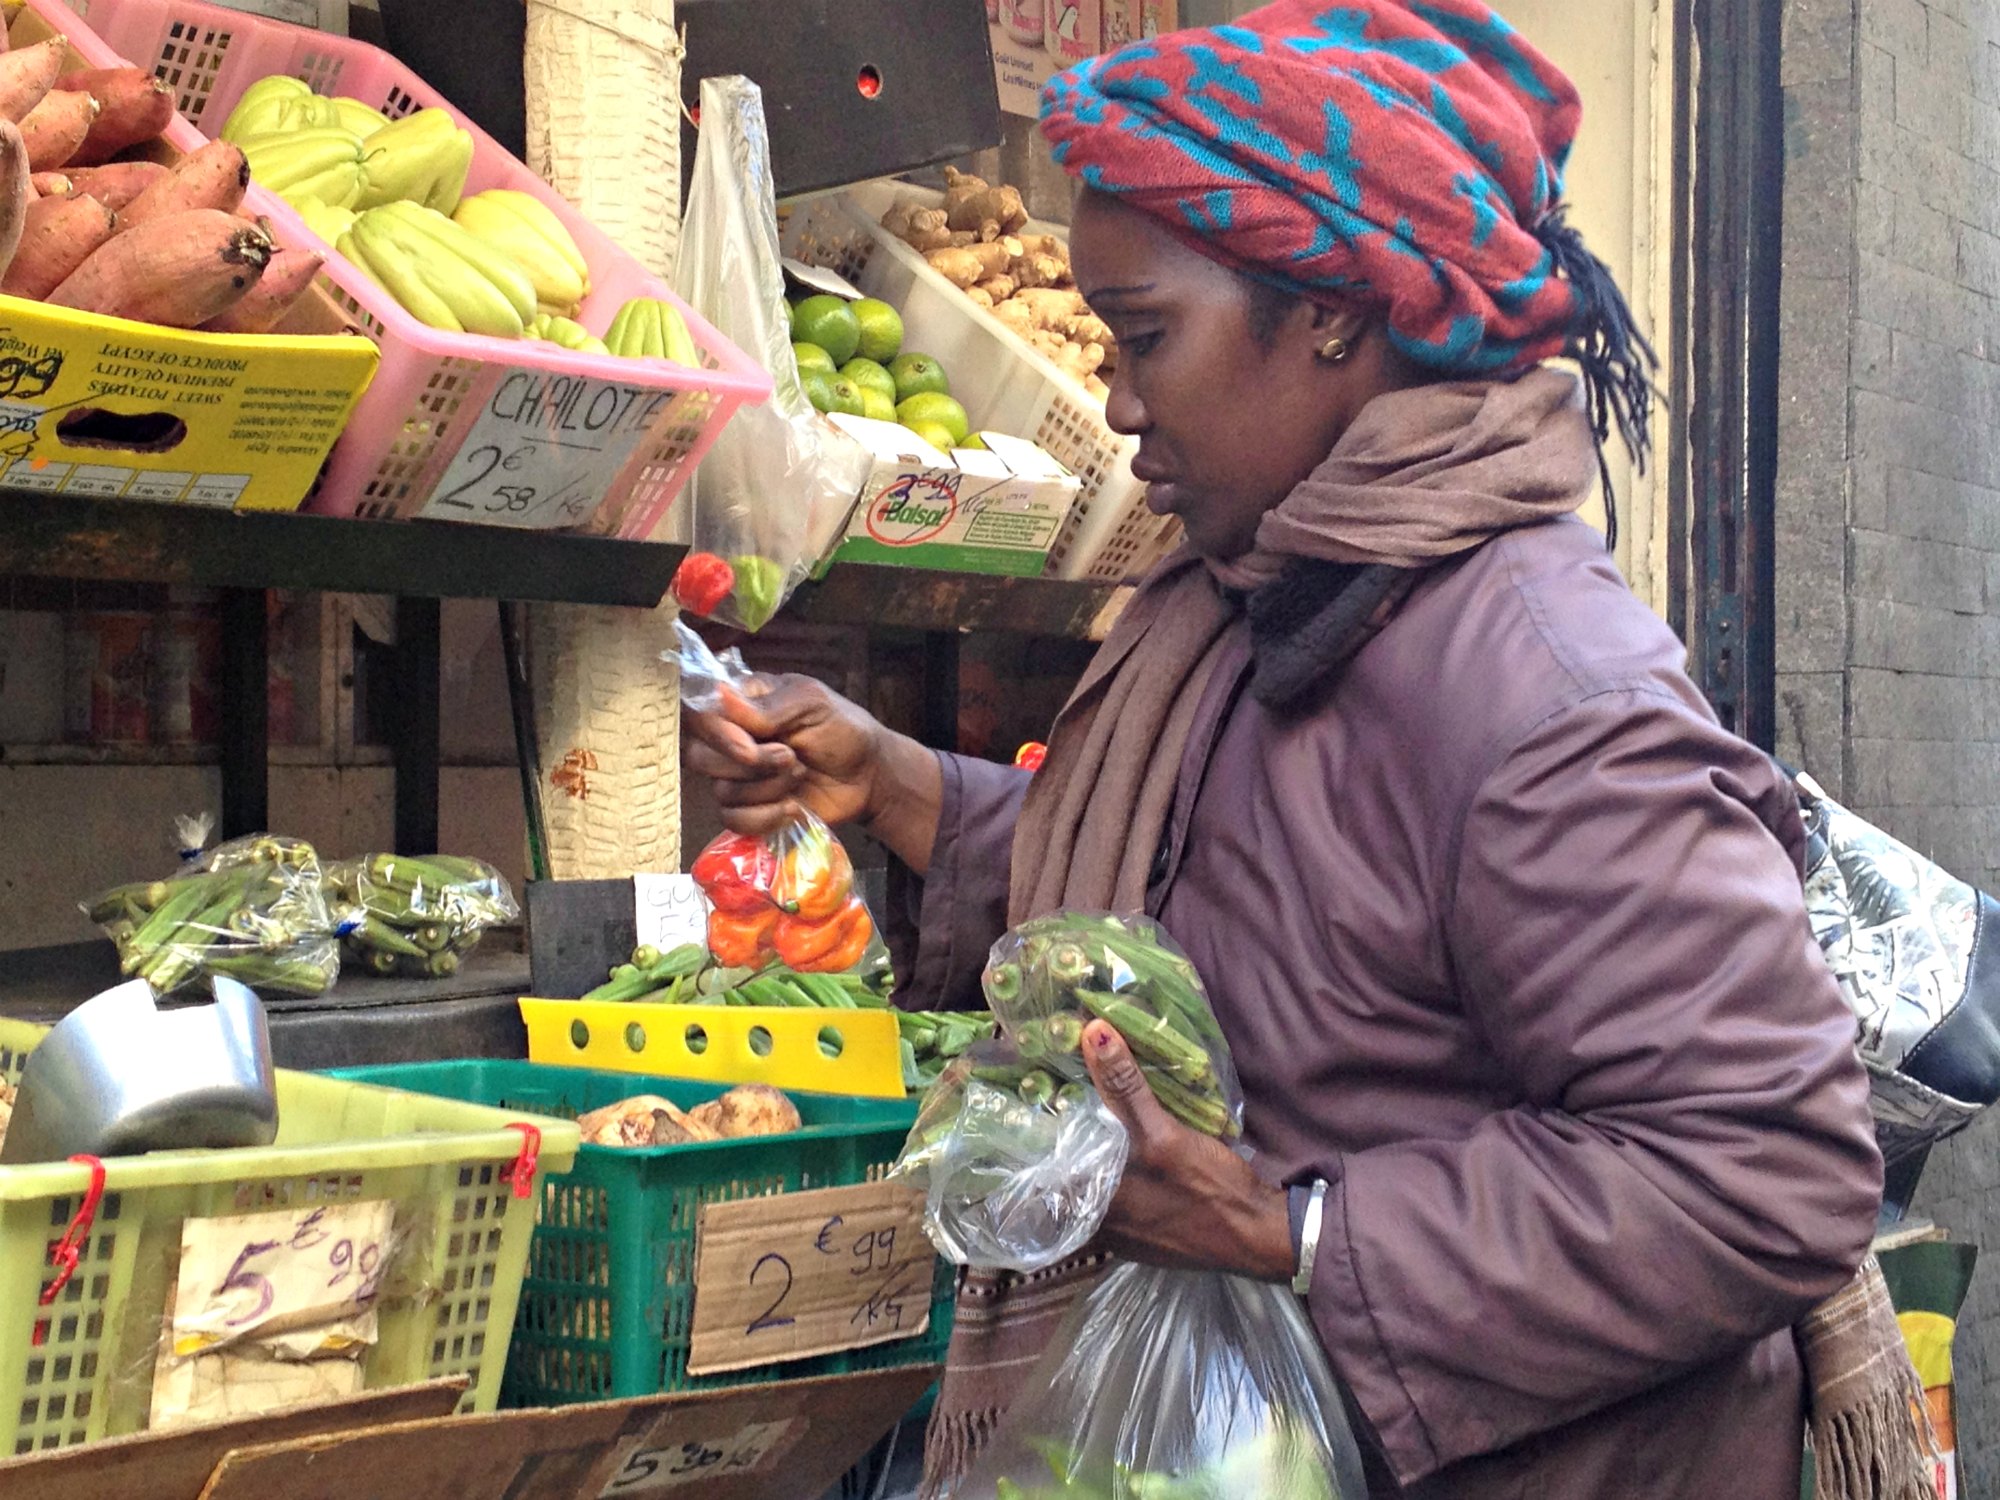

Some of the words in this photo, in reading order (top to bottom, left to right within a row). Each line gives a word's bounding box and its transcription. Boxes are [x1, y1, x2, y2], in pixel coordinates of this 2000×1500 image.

[99, 343, 153, 362] EGYPT
[155, 352, 178, 365] OF
[91, 362, 164, 382] QUALITY
[180, 355, 249, 372] PRODUCE
[166, 372, 235, 387] PREMIUM
[87, 379, 168, 401] POTATOES
[173, 391, 224, 405] SWEET
